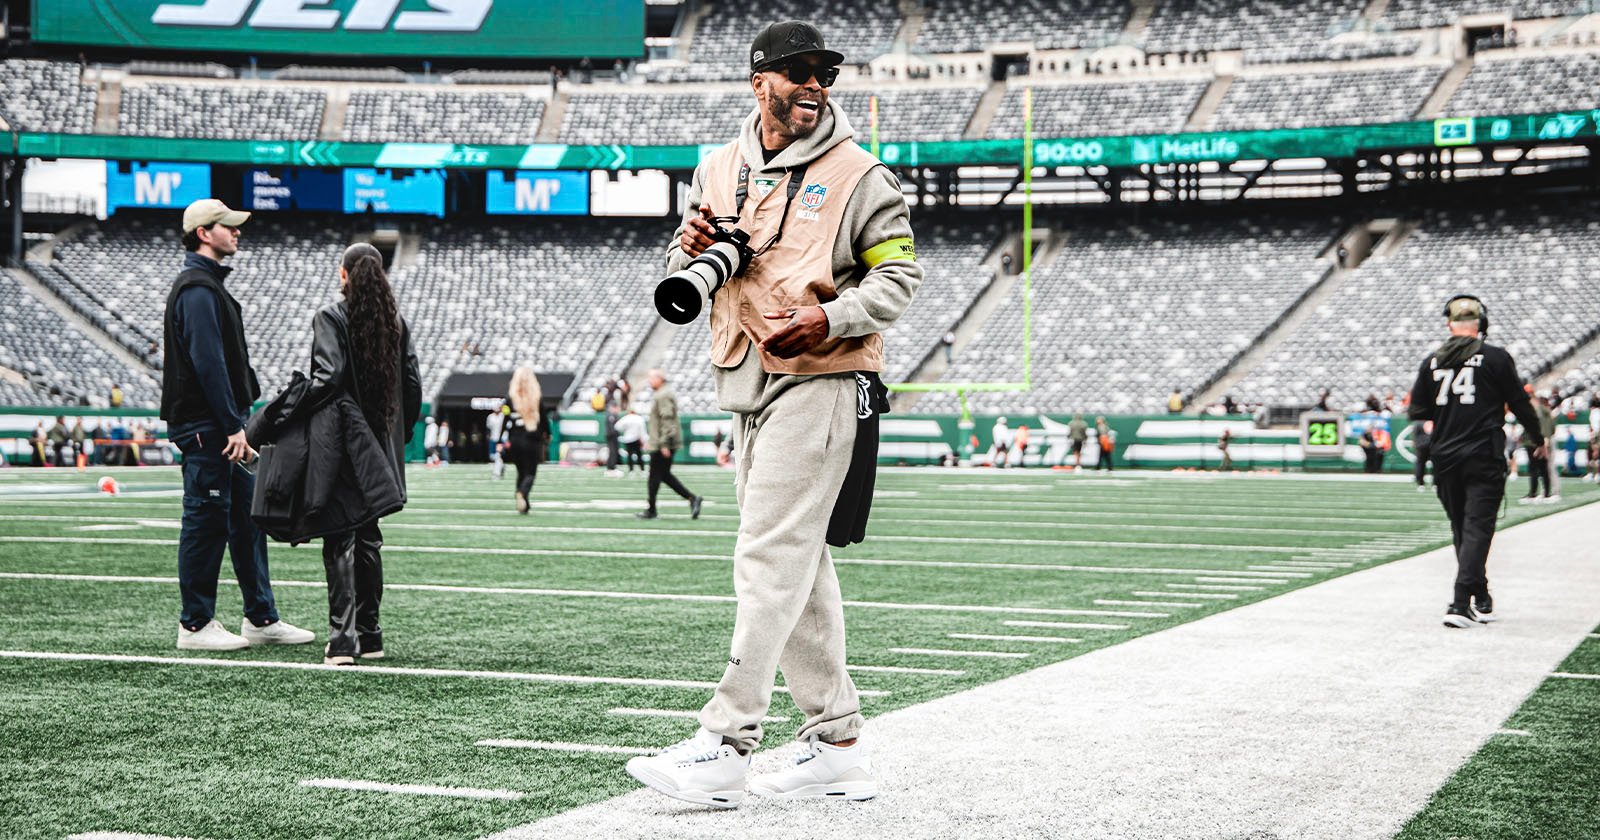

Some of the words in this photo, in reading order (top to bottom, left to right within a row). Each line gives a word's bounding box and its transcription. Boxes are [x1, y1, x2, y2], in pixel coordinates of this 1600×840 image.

[1034, 141, 1103, 163] 90:00
[1161, 137, 1240, 160] MetLife
[804, 192, 821, 205] NFL
[1433, 366, 1476, 406] 74
[1308, 422, 1338, 445] 25
